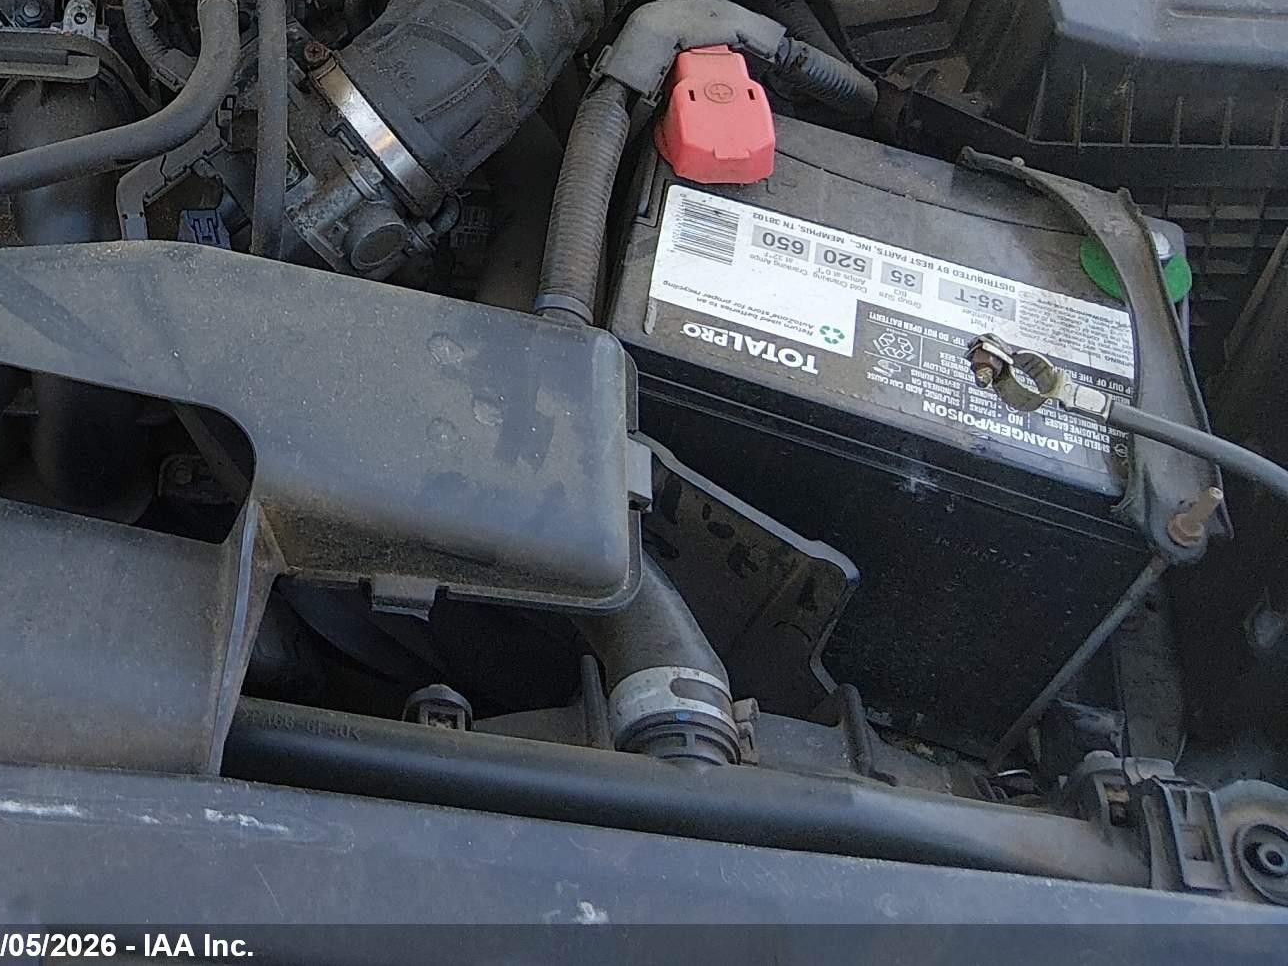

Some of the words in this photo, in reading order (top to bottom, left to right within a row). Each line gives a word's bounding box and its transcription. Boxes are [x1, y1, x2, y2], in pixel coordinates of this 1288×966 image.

[781, 220, 795, 229] TN
[796, 223, 845, 244] MEMPHIS,
[760, 230, 805, 256] 650
[821, 247, 867, 273] 520
[872, 245, 907, 262] PARTS,
[909, 256, 934, 270] BEST
[936, 263, 950, 274] BY
[887, 268, 917, 287] 35
[951, 268, 1016, 293] DISTRIBUTED
[661, 279, 701, 296] recycling
[702, 290, 732, 305] proper
[953, 286, 1004, 312] 35-T
[719, 303, 758, 320] batteries
[732, 301, 746, 310] for
[746, 305, 770, 317] store
[759, 315, 781, 326] used
[868, 310, 903, 327] BATTERY!
[960, 306, 995, 322] Number
[782, 322, 813, 336] Return
[902, 320, 923, 333] OPEN
[922, 326, 938, 338] NOT
[937, 331, 950, 341] DO
[680, 317, 822, 375] TOTALPRO
[909, 368, 935, 381] BURNS
[922, 360, 951, 375] FOLLOW
[865, 370, 890, 384] CAUSE
[888, 377, 904, 389] CAN
[933, 375, 961, 389] SEVERE
[1076, 371, 1095, 383] THE
[1094, 377, 1108, 387] OF
[904, 382, 923, 394] ACID
[1107, 381, 1125, 392] OUT
[923, 389, 961, 406] SULFURIC
[968, 394, 997, 409] FLAMES
[967, 402, 997, 418] SPARKS
[920, 399, 1059, 450] DANGER/POISON
[1005, 411, 1025, 427] NO
[1042, 416, 1069, 431] GASES
[1062, 432, 1083, 445] EYES
[1067, 424, 1111, 443] EXPLOSIVE
